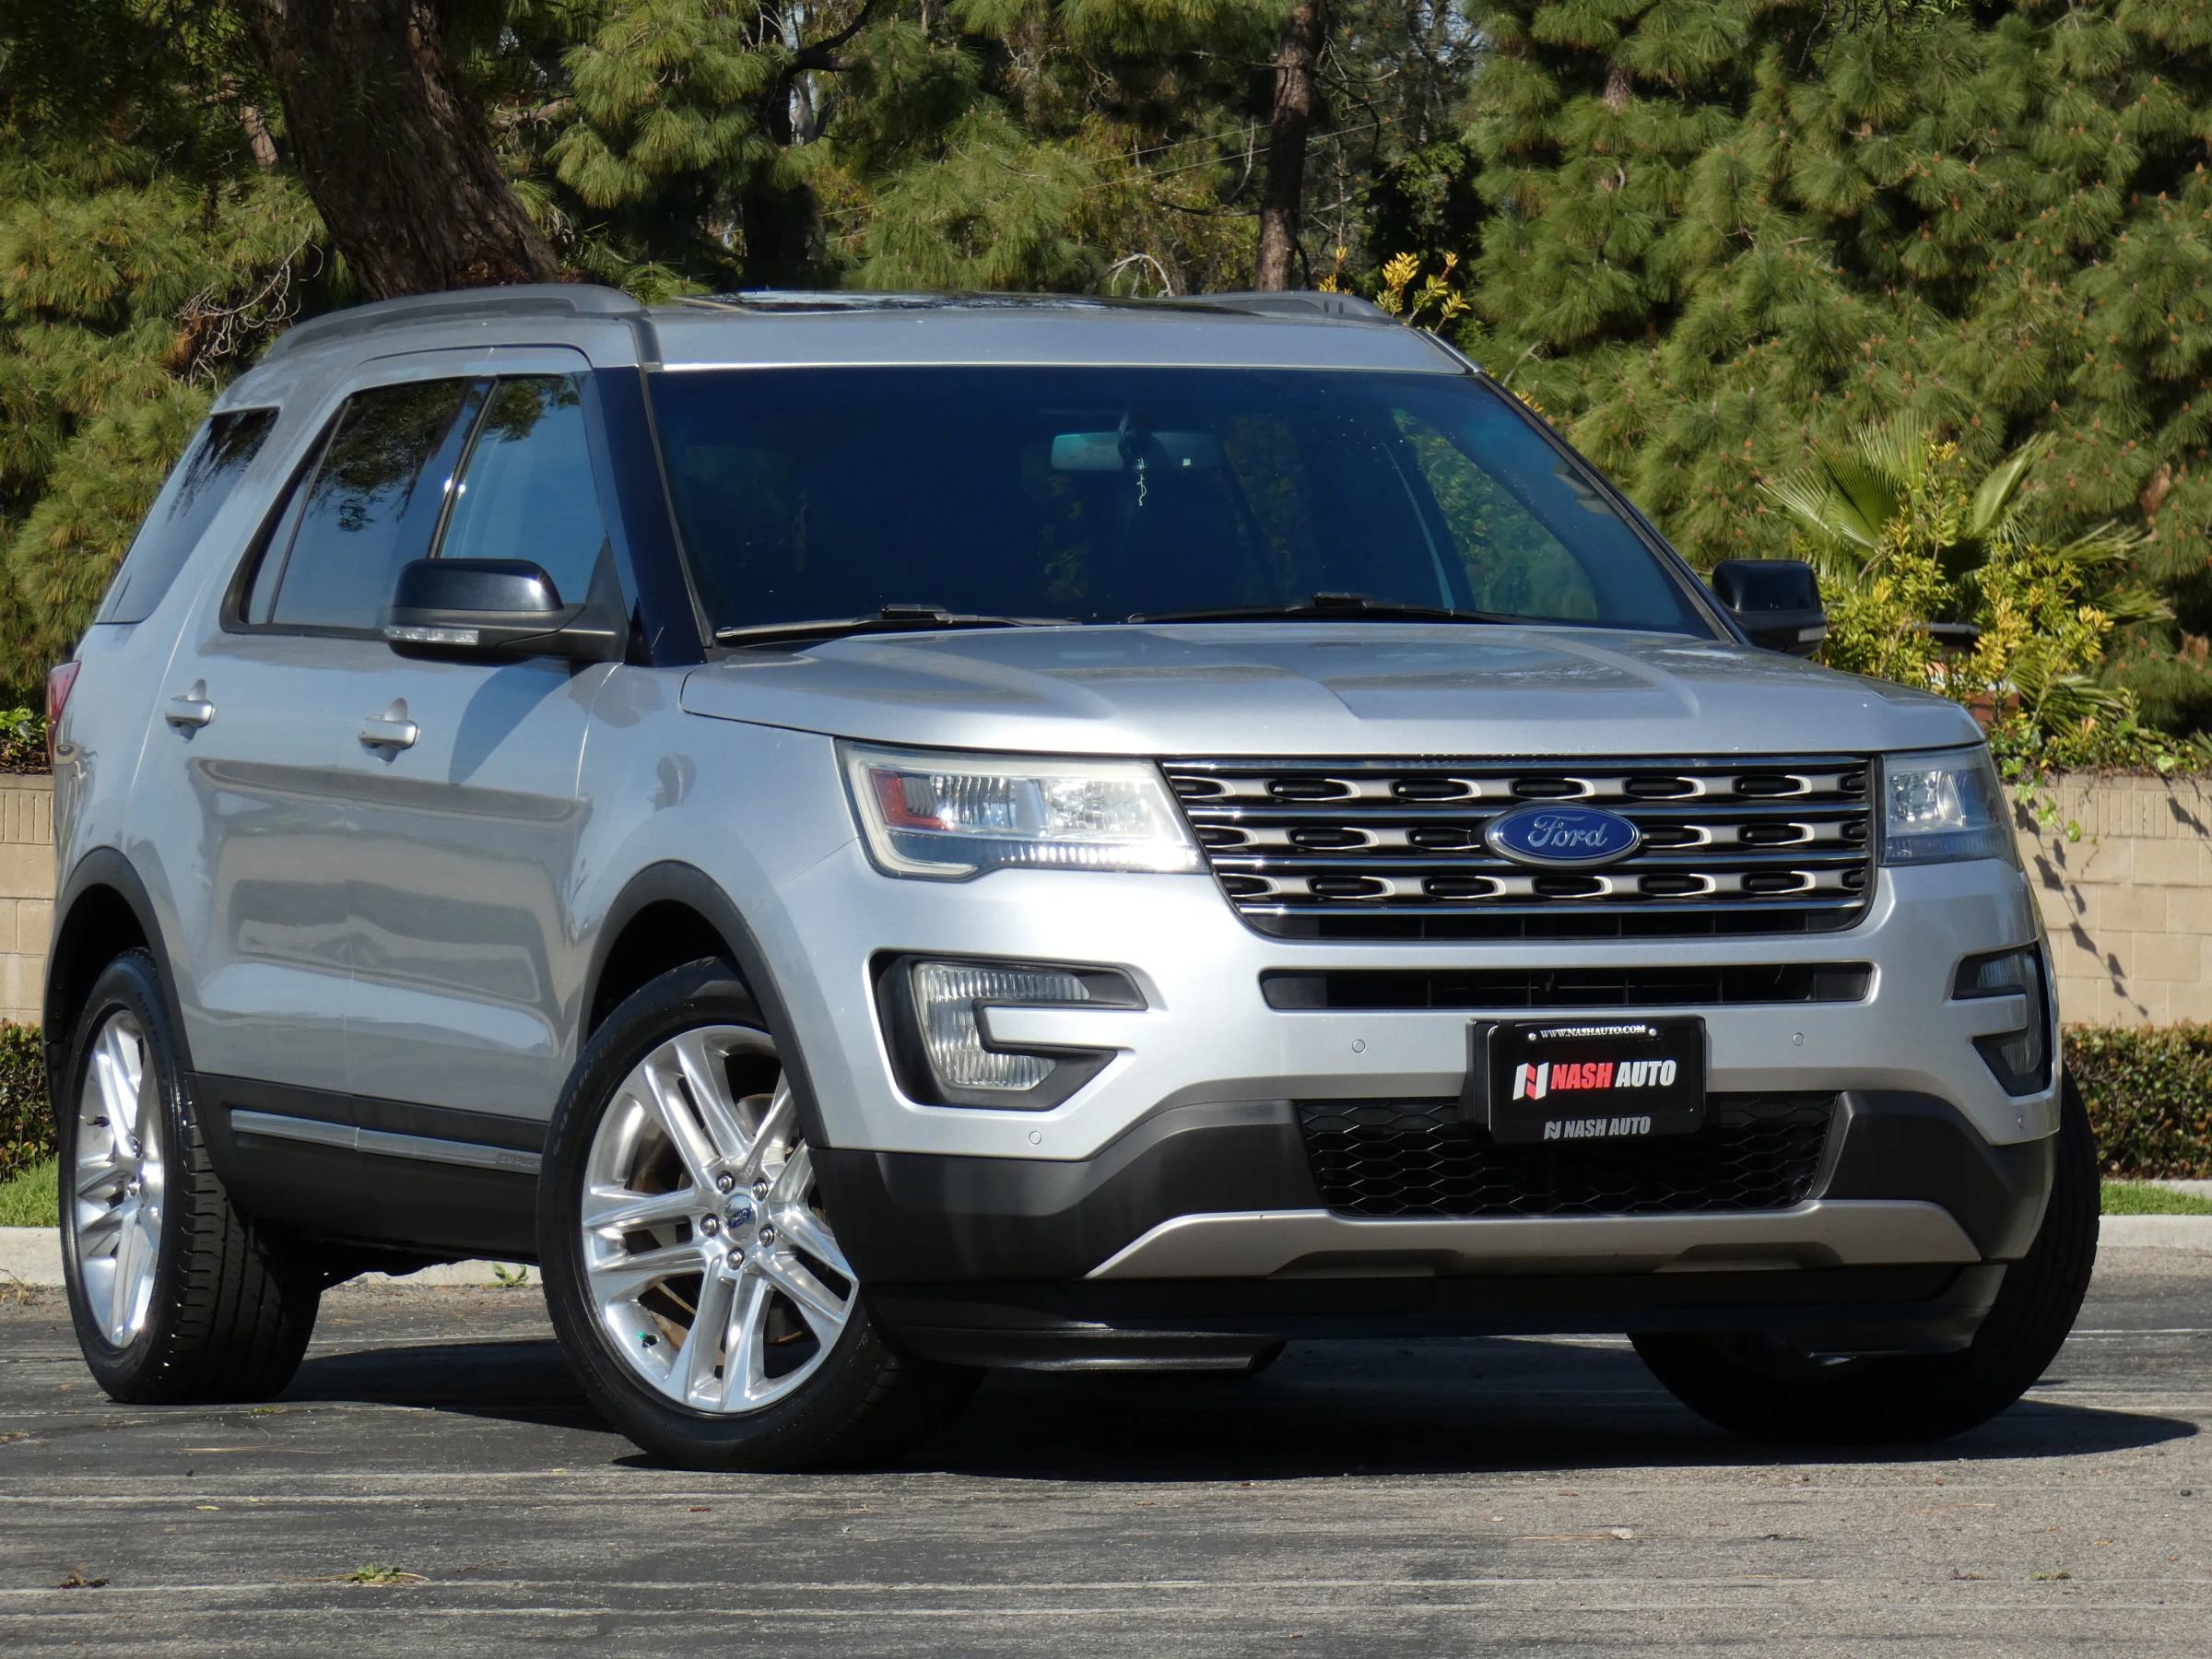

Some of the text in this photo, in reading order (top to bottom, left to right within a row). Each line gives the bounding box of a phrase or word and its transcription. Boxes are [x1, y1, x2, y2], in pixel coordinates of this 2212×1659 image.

[1527, 814, 1608, 847] Ford
[1540, 1025, 1645, 1039] WWW.NASHAUTO.COM
[1550, 1063, 1614, 1090] NASH
[1615, 1060, 1677, 1088] AUTO
[1563, 1118, 1606, 1139] NASH
[1608, 1116, 1651, 1136] AUTO
